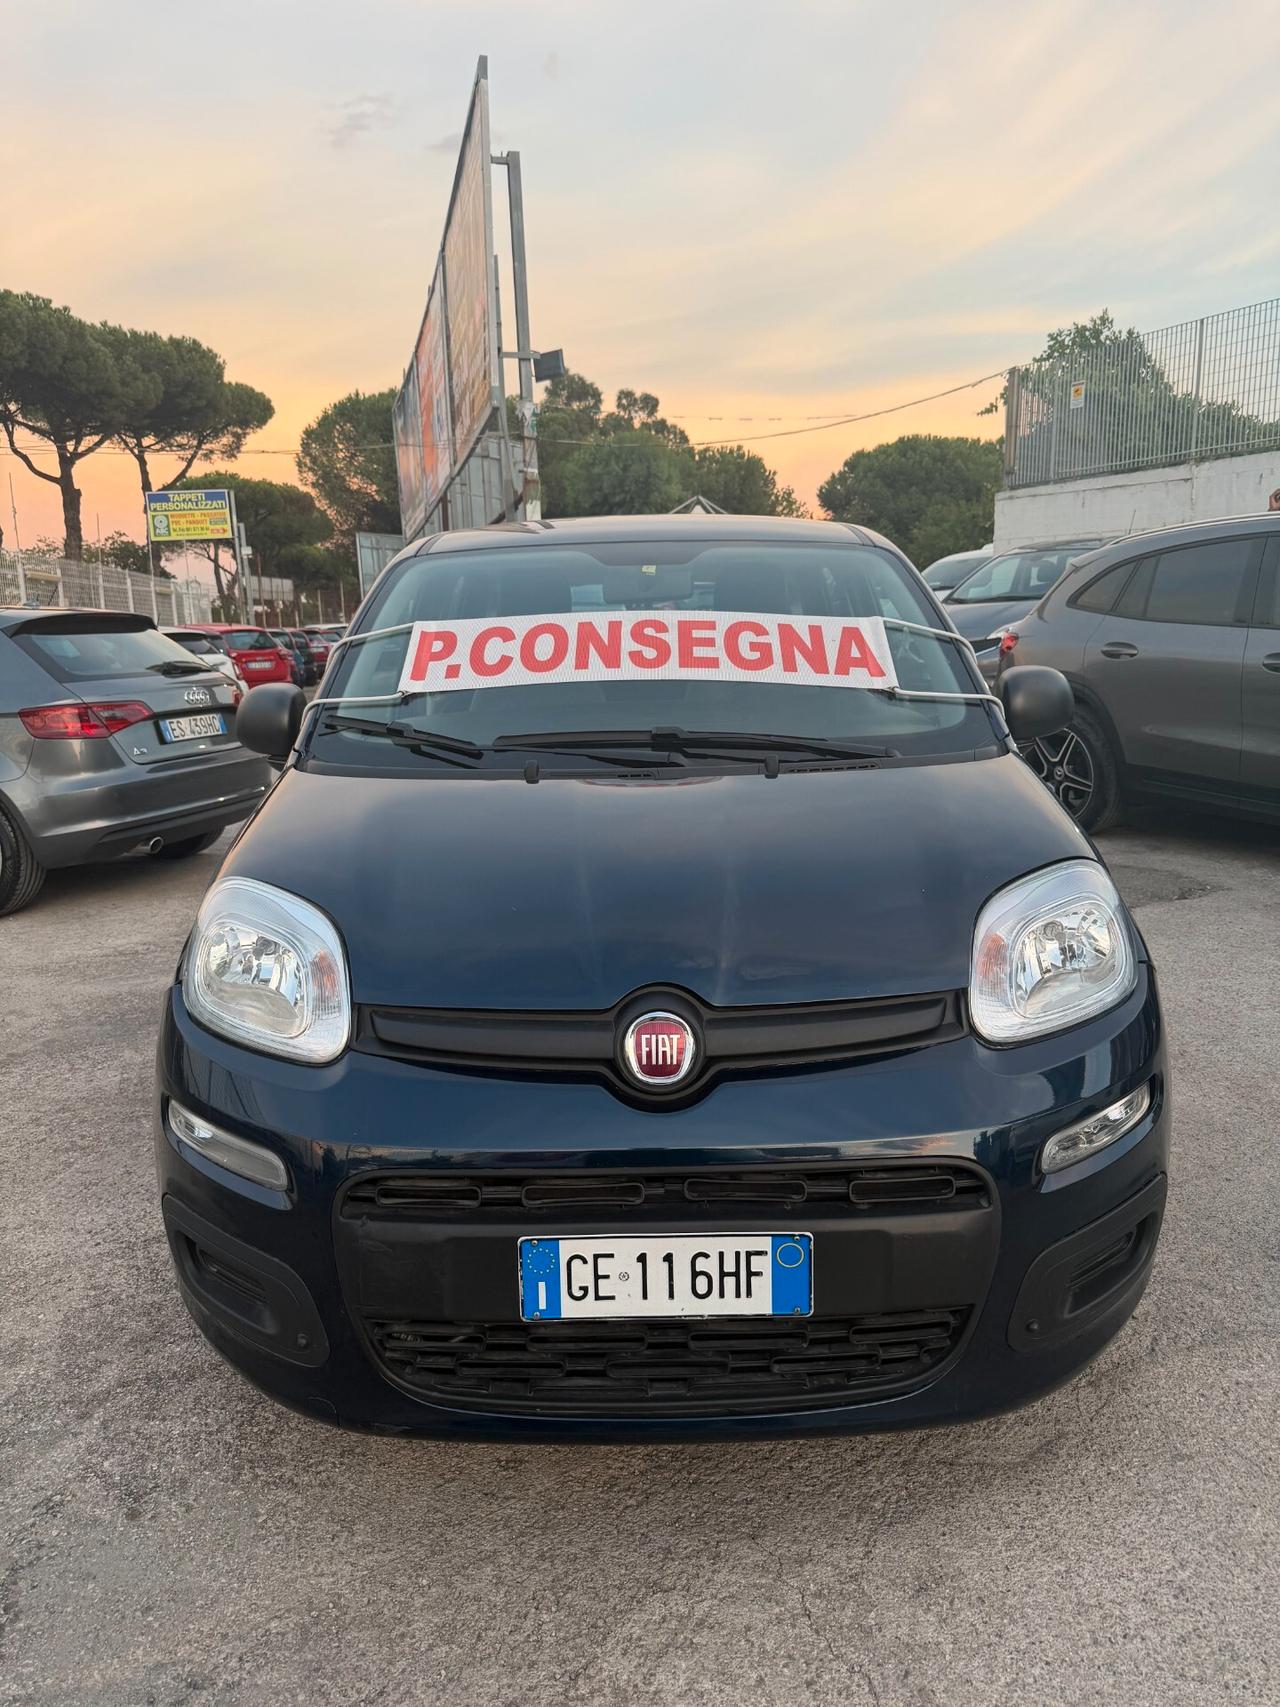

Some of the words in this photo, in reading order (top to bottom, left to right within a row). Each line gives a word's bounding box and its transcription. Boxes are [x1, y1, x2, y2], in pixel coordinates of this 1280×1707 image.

[150, 501, 226, 511] PERSONALIZZATI
[168, 493, 205, 502] TAPPETI
[409, 619, 886, 681] P.CONSEGNA
[168, 720, 186, 738] ES
[188, 715, 221, 736] 439HC
[641, 1034, 681, 1065] FIAT
[566, 1252, 616, 1301] GE
[636, 1249, 769, 1301] 116HF
